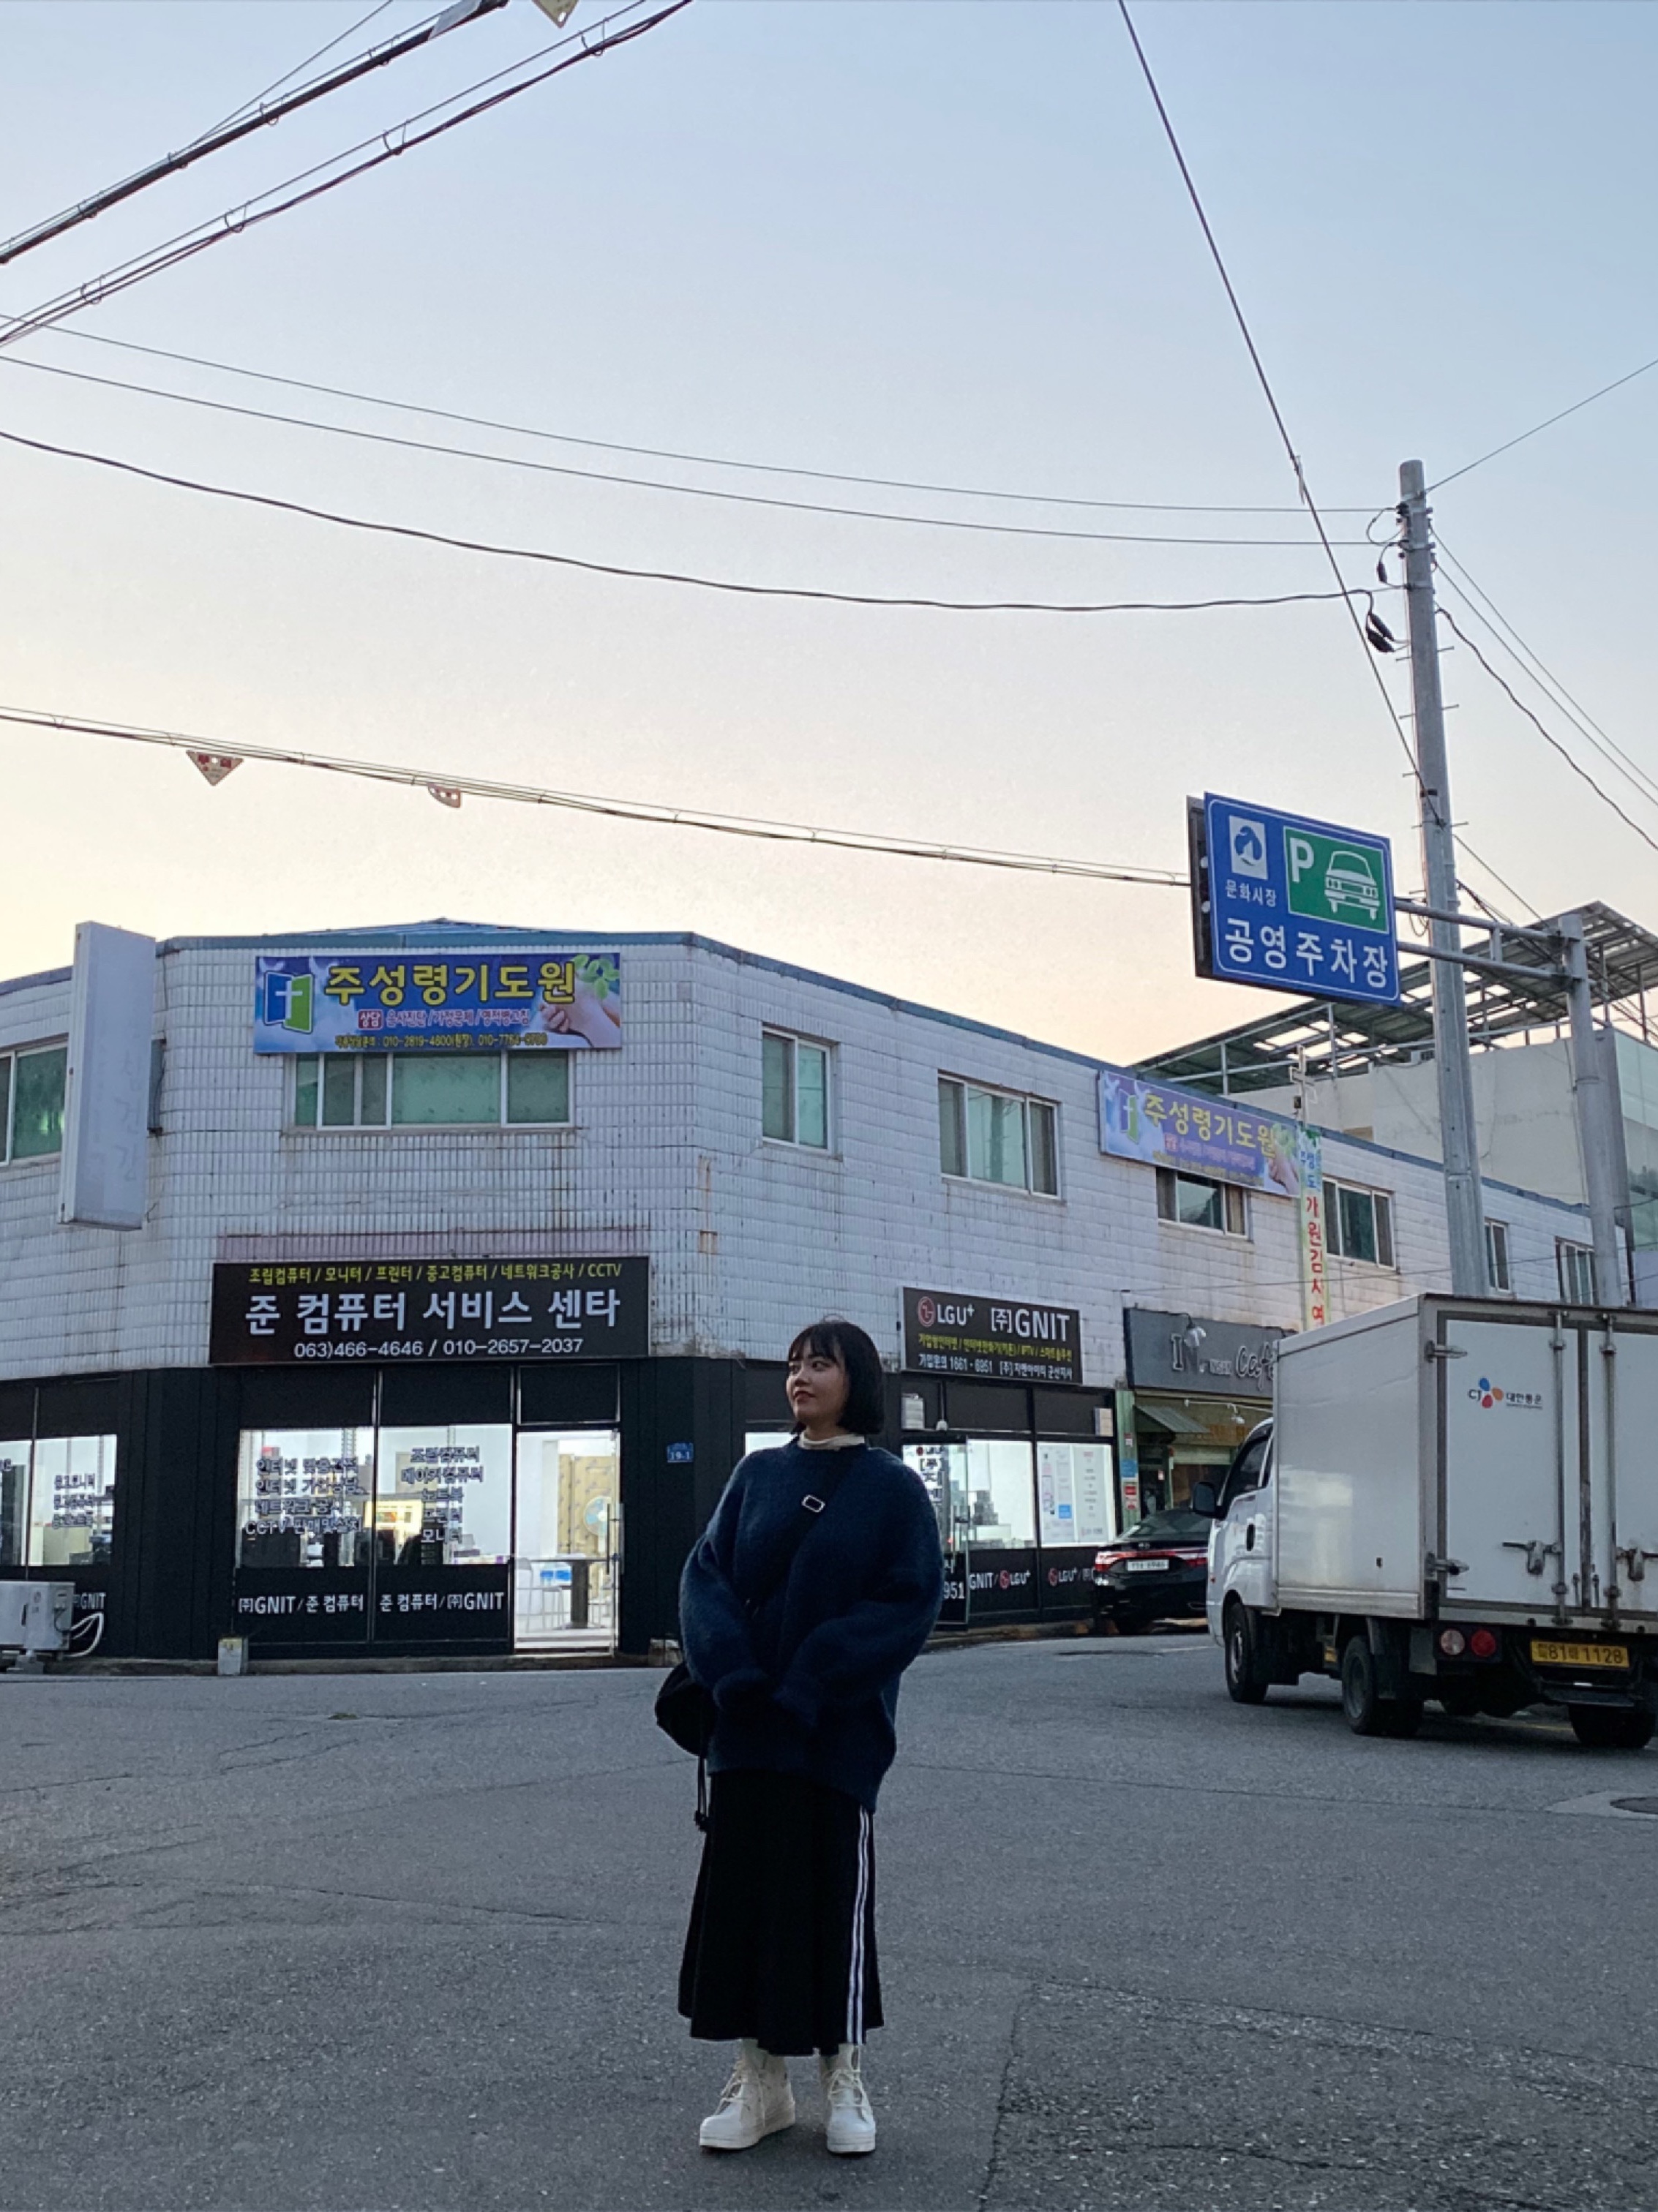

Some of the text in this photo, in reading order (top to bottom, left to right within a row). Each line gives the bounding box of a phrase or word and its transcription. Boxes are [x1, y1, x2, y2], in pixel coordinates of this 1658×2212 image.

[1290, 838, 1314, 883] P
[1225, 879, 1277, 908] 문화시장
[1225, 917, 1388, 988] 공영주차장
[325, 962, 577, 1006] 주성령기도원
[1144, 1092, 1278, 1159] 주성령기도원
[249, 1265, 312, 1284] 조립컴퓨터
[325, 1265, 361, 1283] 모니터
[375, 1265, 413, 1282] 프린터
[427, 1264, 488, 1282] 중고컴퓨터
[501, 1263, 575, 1281] 네트워크공사
[588, 1263, 622, 1278] CCTV
[245, 1289, 620, 1336] 준 컴퓨터 서비스 센타
[293, 1342, 424, 1359] 063)466-4646
[443, 1339, 584, 1355] 010-2657-2037
[1468, 1388, 1482, 1402] CJ
[410, 1446, 480, 1463] 조립컴퓨터
[256, 1456, 298, 1475] 인터넷
[255, 1478, 297, 1495] 인터넷
[245, 1520, 287, 1535] CCTV
[421, 1527, 462, 1545] 모니터
[323, 1594, 364, 1614] 컴퓨터
